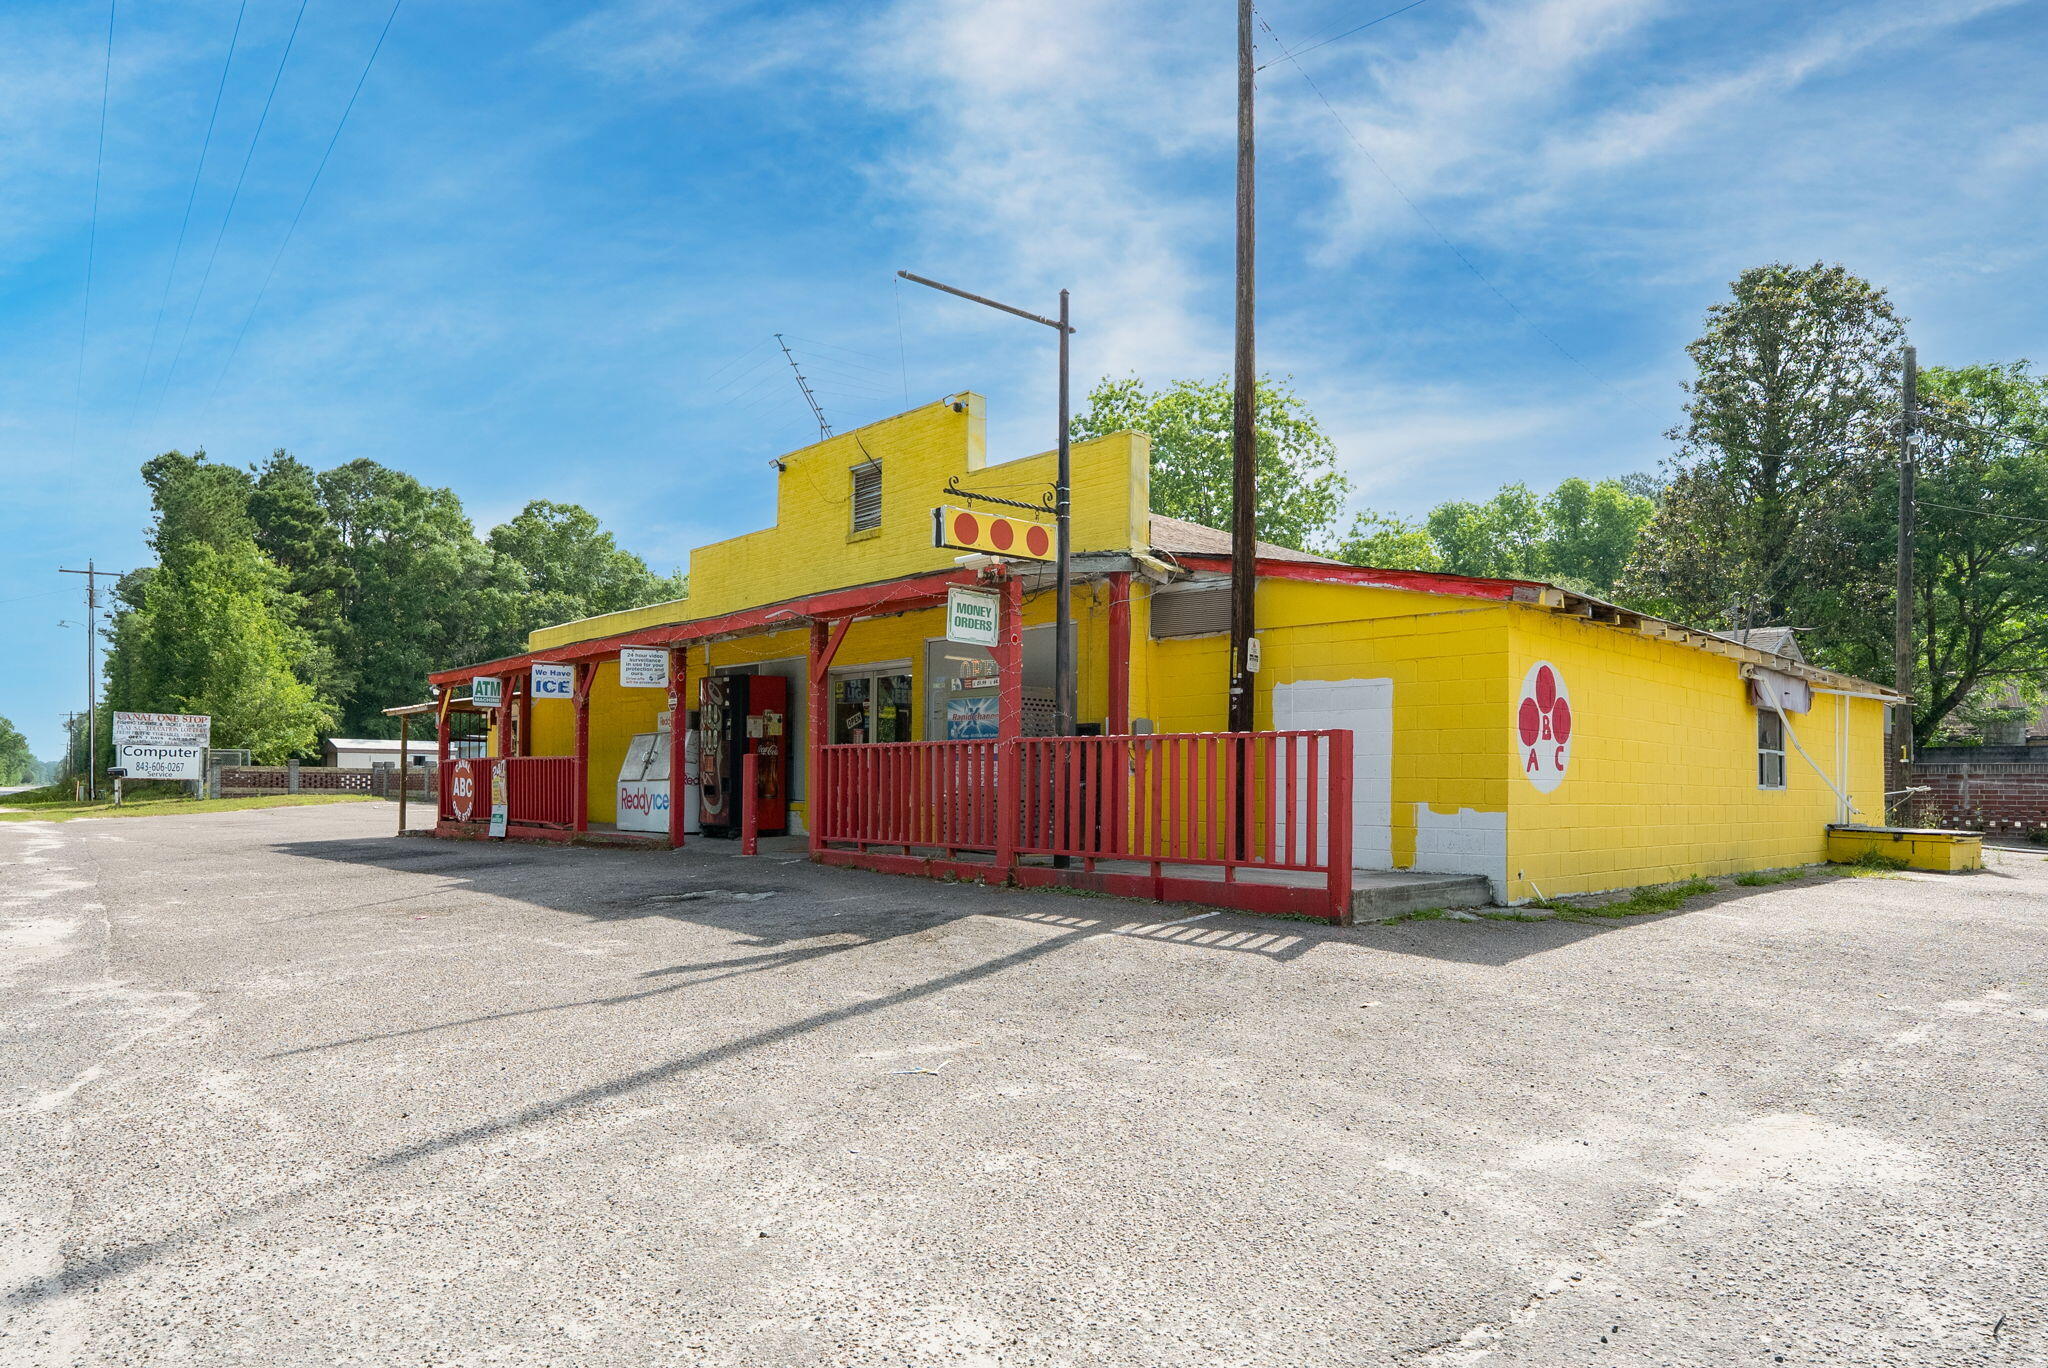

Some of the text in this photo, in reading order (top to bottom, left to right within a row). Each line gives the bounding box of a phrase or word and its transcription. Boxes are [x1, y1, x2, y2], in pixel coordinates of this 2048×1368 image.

[957, 602, 992, 618] MONEY
[954, 616, 993, 632] ORDERS
[550, 669, 572, 677] Have
[474, 680, 500, 697] ATM
[535, 680, 570, 694] ICE
[117, 713, 208, 724] CANAL ONE STOP
[847, 713, 862, 727] OPEN
[1541, 714, 1552, 740] B
[123, 745, 198, 760] Computer
[1526, 745, 1565, 773] A C
[135, 761, 185, 772] 843-606-0267
[452, 777, 473, 798] ABC
[452, 800, 462, 820] ONE
[461, 801, 473, 822] STOP
